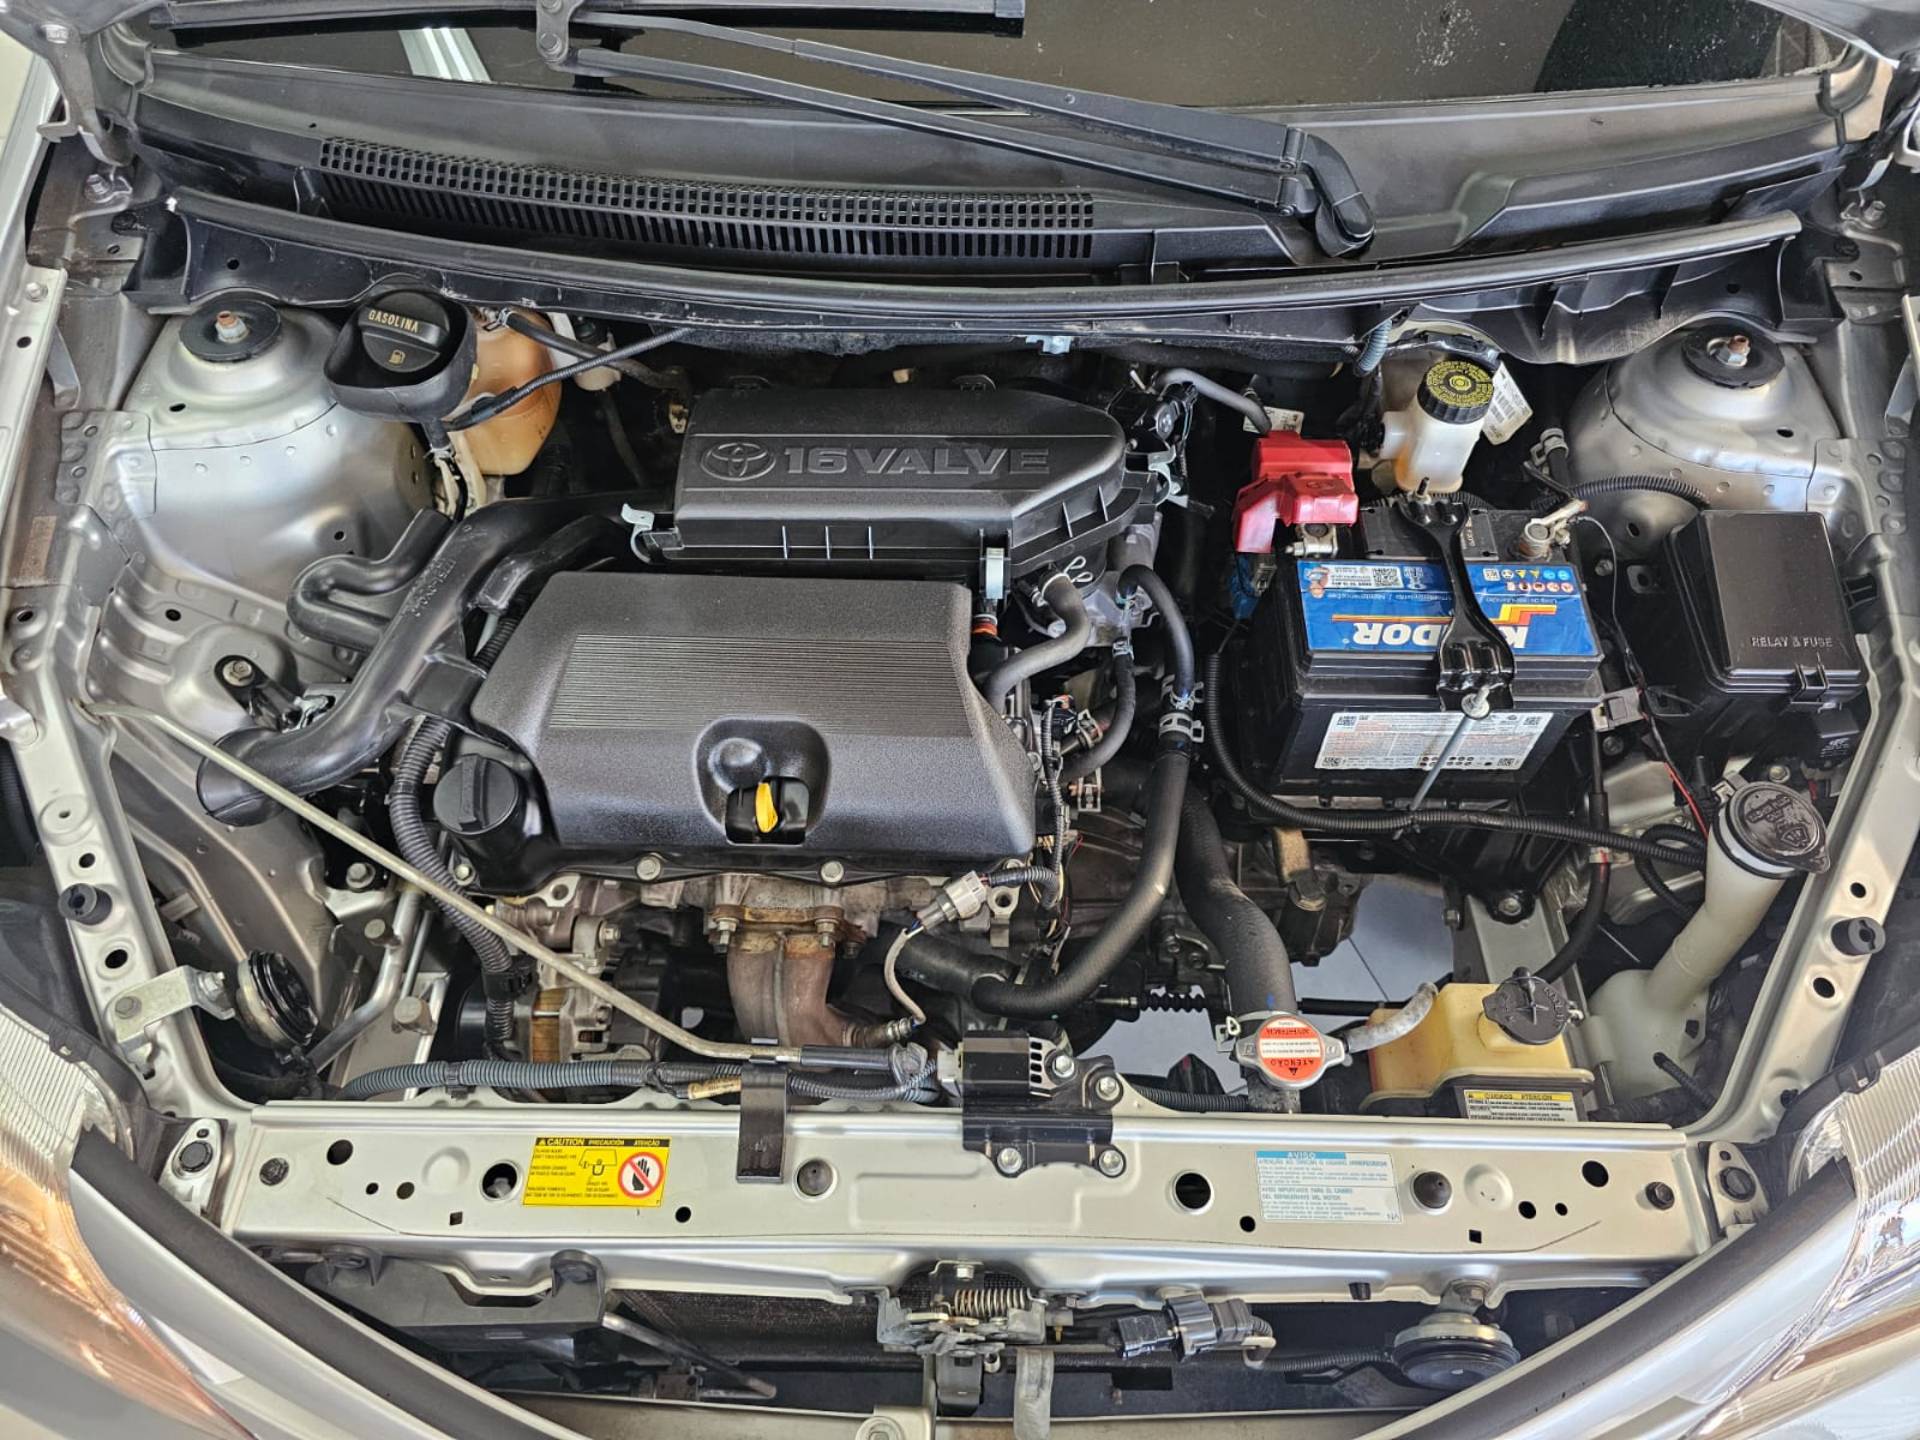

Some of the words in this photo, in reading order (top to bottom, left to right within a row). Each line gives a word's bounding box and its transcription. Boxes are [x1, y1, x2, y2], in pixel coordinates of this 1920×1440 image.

[367, 309, 420, 334] GASOLINA
[1352, 621, 1530, 650] KDOR
[1751, 636, 1788, 648] RELAY
[1803, 636, 1833, 648] FUSE
[546, 1138, 584, 1146] CAUTION
